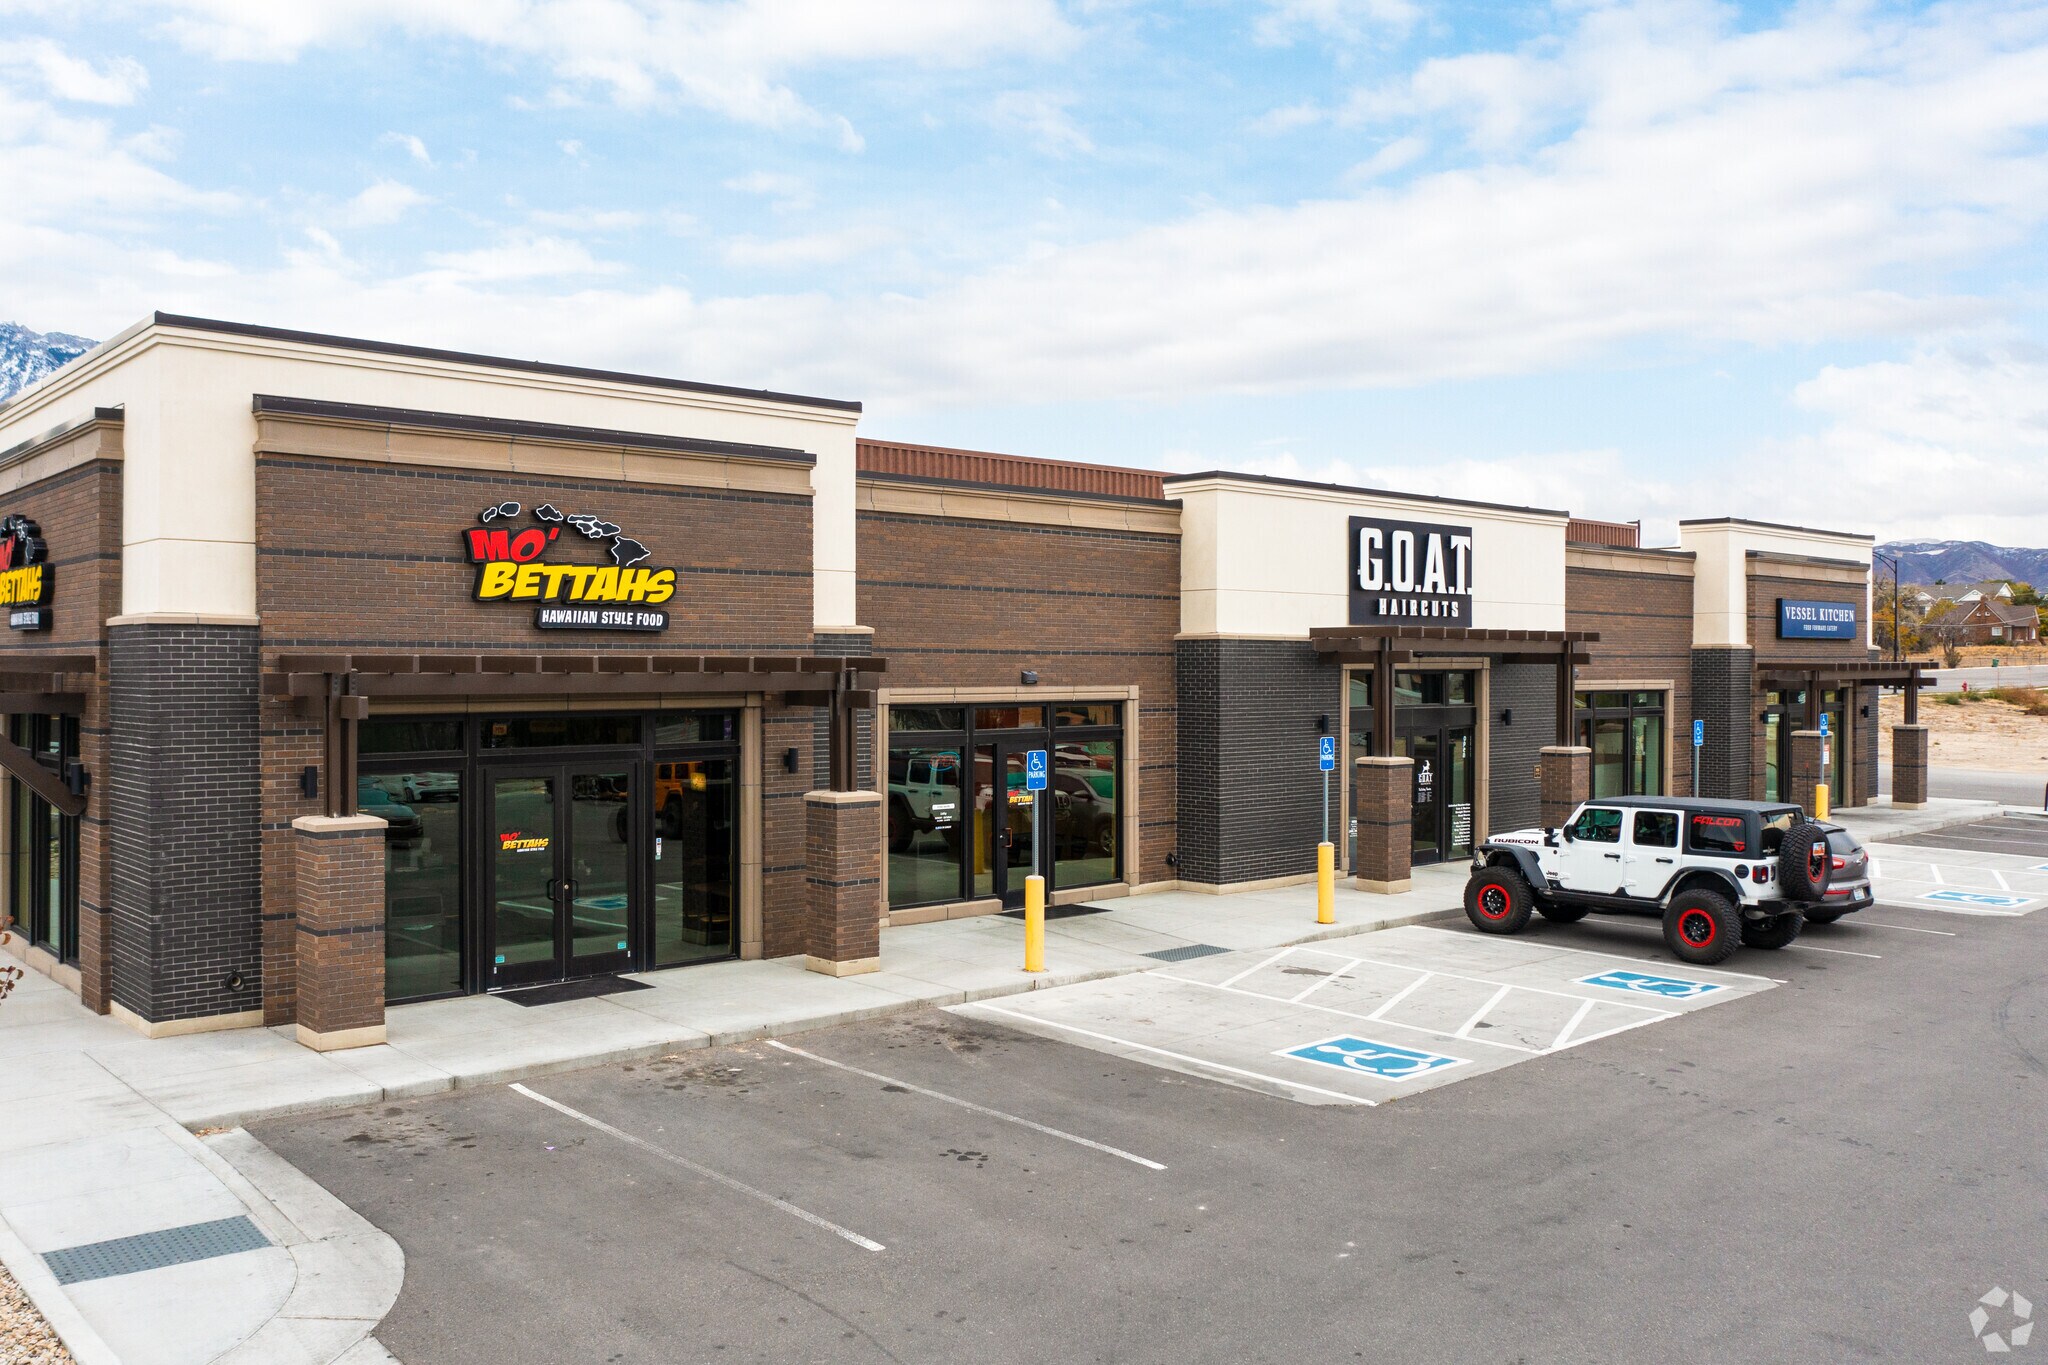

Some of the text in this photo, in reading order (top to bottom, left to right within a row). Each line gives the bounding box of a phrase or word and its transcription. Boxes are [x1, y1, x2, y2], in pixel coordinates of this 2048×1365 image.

[469, 527, 560, 562] MO'
[0, 565, 42, 605] BETTAHS
[479, 563, 678, 604] BETTAHS
[1379, 598, 1459, 618] HAIRCUTS
[1785, 606, 1855, 622] VESSEL KITCHEN
[541, 609, 664, 627] HAWAIIAN STYLE FOOD
[1028, 770, 1046, 778] PARKING
[1009, 795, 1034, 803] BETTAH
[1693, 815, 1742, 827] FALCON
[500, 831, 521, 841] MO'
[502, 838, 549, 850] BETTAHS
